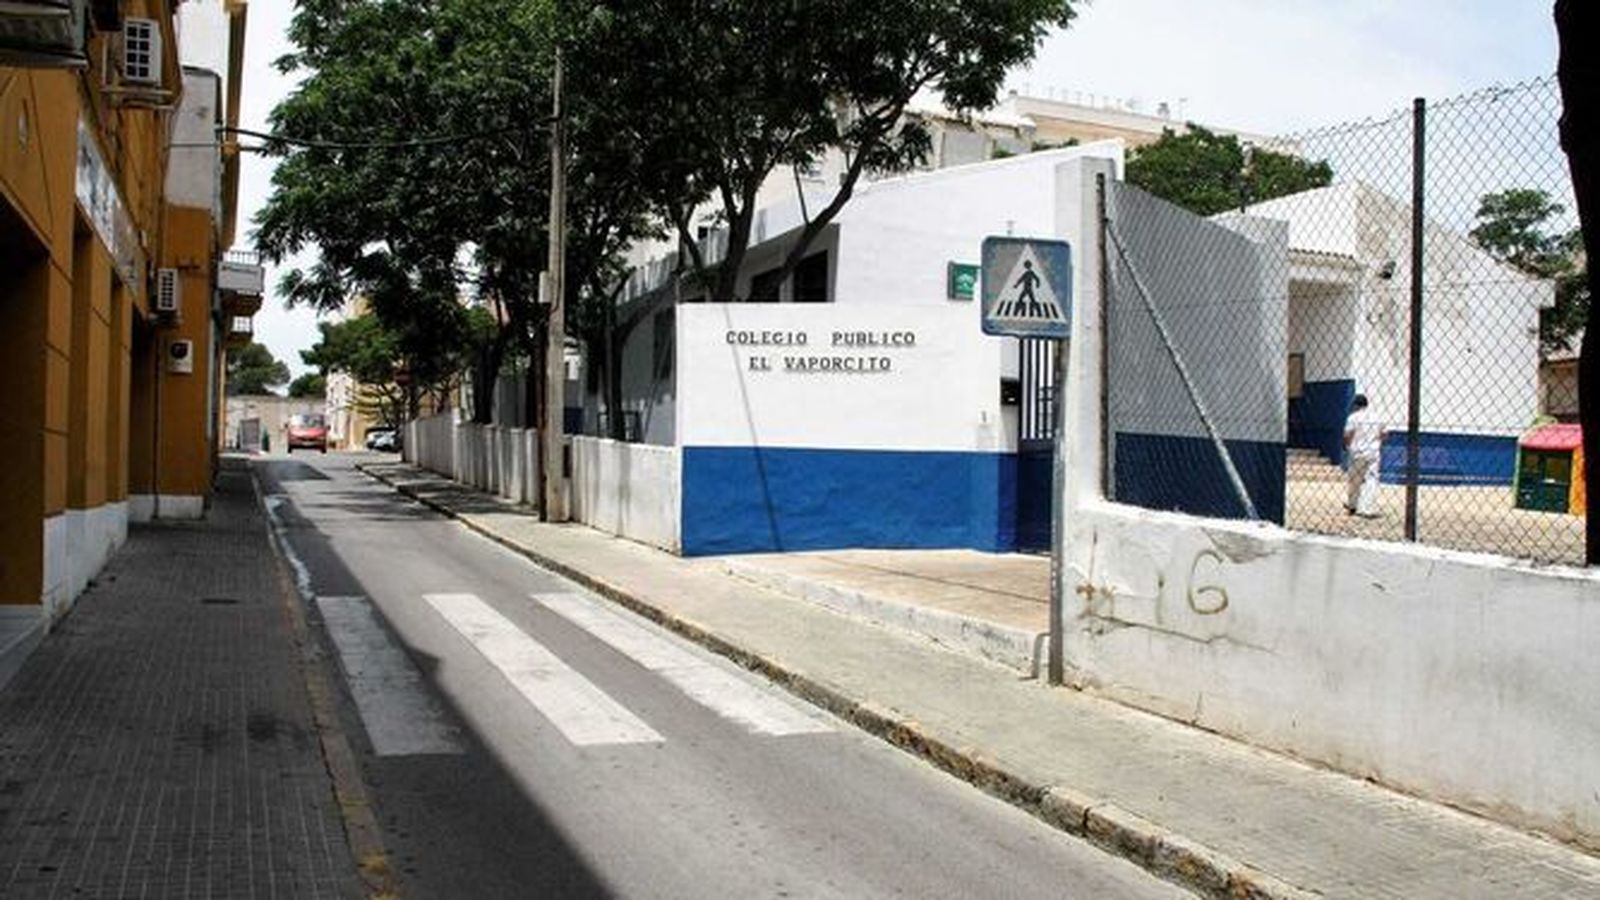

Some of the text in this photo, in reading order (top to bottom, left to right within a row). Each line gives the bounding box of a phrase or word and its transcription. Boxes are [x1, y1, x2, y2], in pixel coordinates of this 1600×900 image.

[725, 330, 917, 347] COLEGIO PUBLICO
[748, 356, 892, 373] EL VAPORCITO
